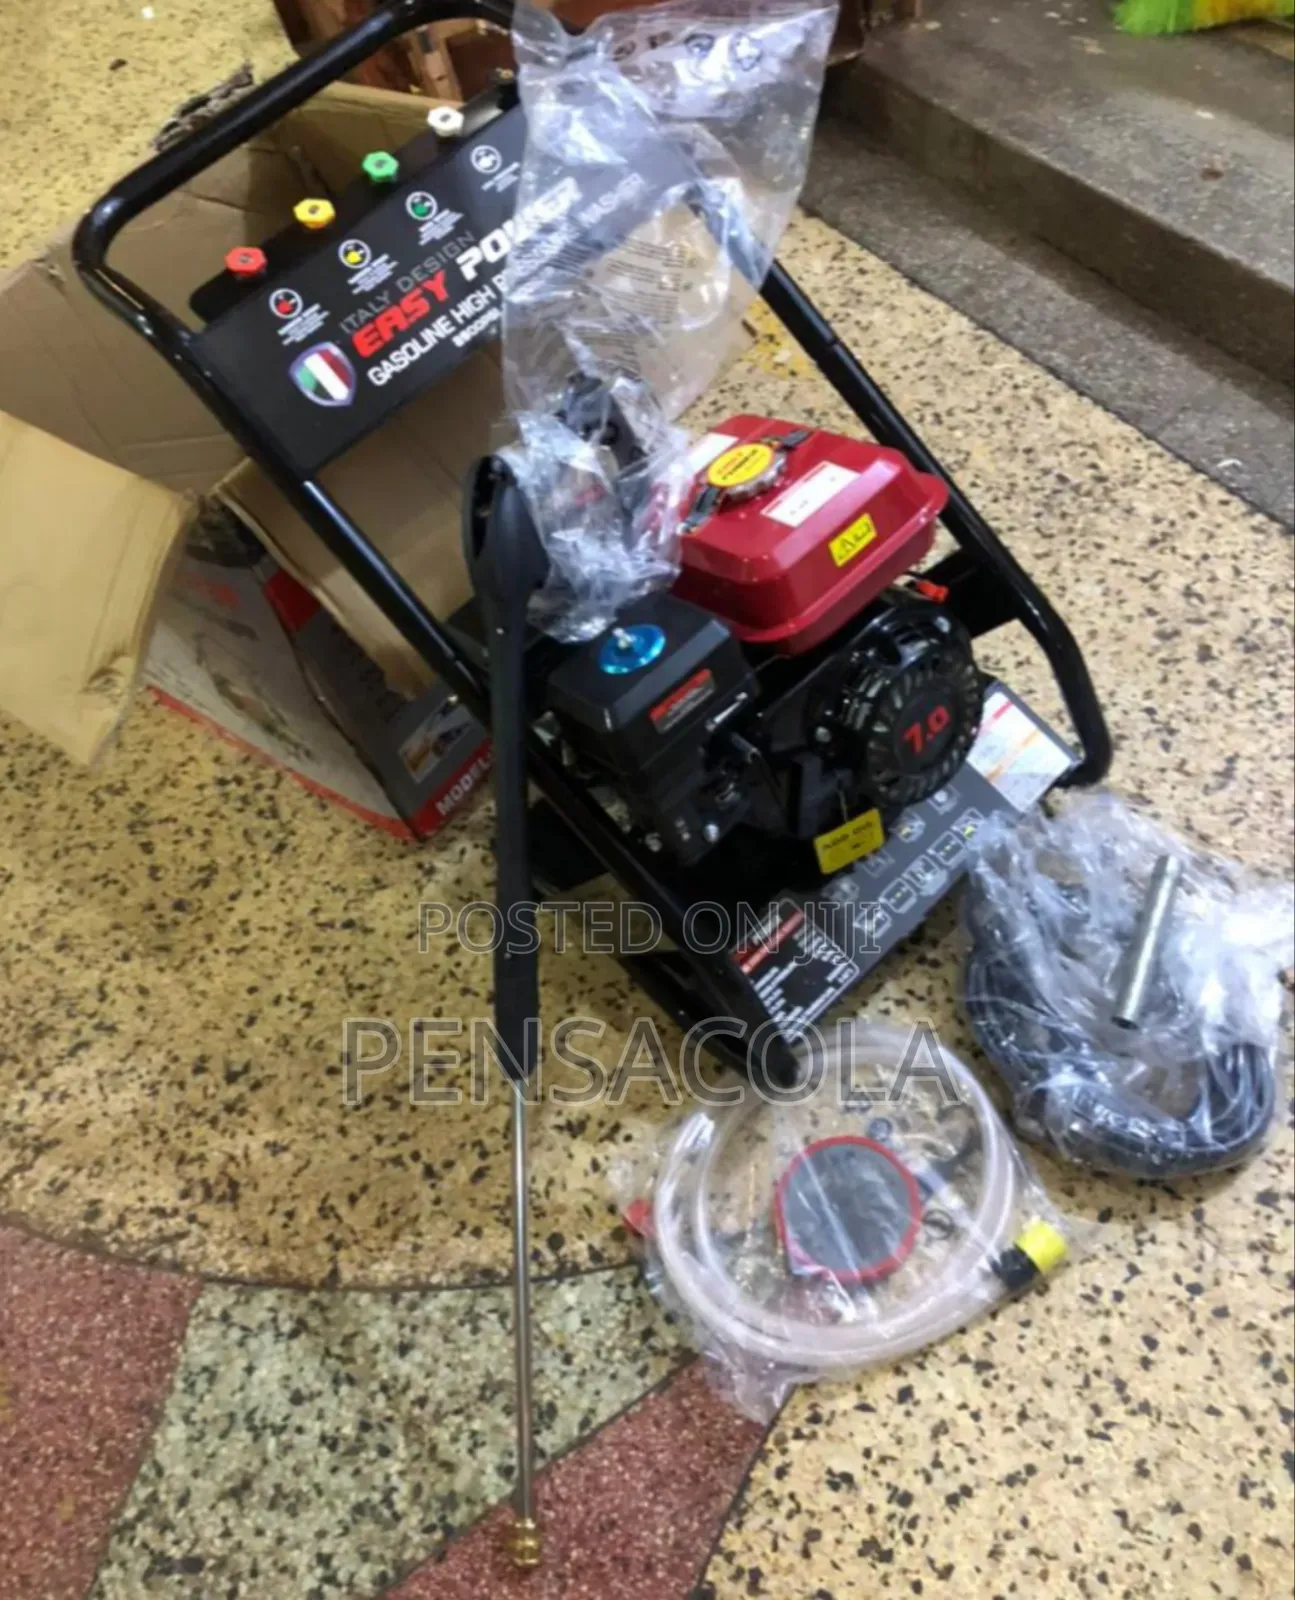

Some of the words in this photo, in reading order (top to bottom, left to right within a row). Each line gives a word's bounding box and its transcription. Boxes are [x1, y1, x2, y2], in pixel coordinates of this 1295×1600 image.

[339, 290, 392, 335] ITALY
[395, 230, 477, 293] DESIGN
[352, 269, 449, 358] EASY
[367, 314, 457, 386] GASOLINE
[450, 284, 497, 324] HIGH
[903, 704, 951, 753] 7.0
